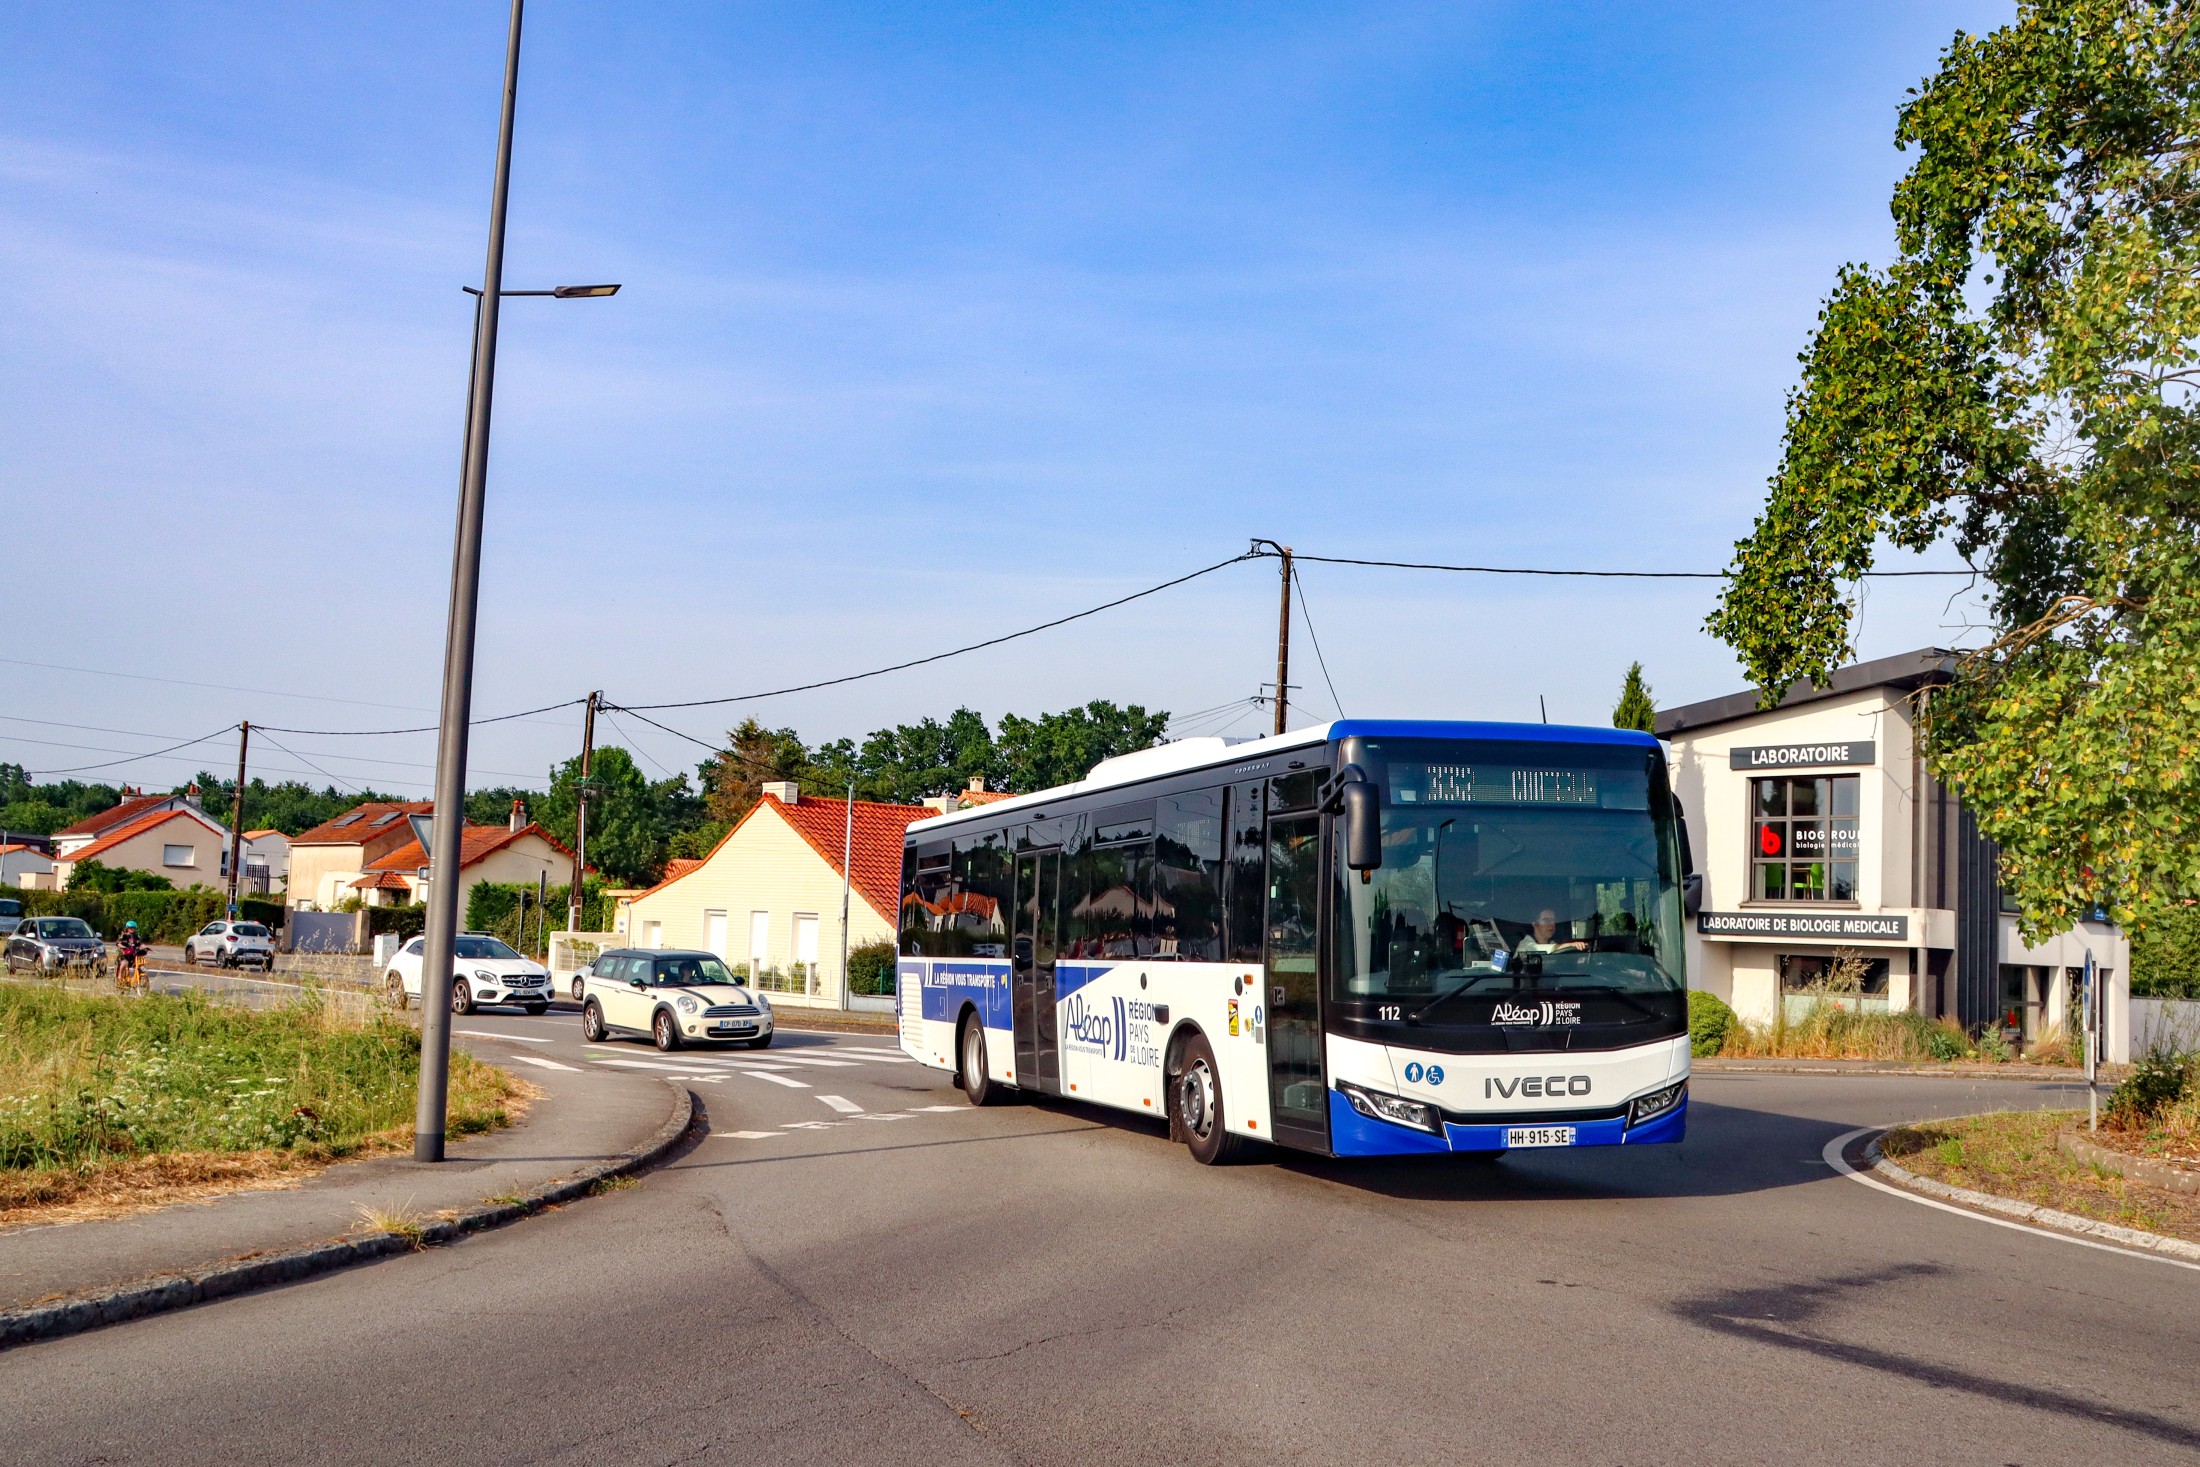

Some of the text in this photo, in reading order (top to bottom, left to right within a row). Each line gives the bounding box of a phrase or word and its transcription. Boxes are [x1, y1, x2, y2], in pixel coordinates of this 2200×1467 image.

[1751, 746, 1849, 764] LABORATOIRE
[1703, 917, 1899, 933] LABORATOIRE DE BIOLOGIE MEDICALE
[934, 972, 940, 984] LA
[955, 973, 967, 986] VOUS
[966, 973, 996, 988] TRANSPORTE
[1128, 998, 1156, 1022] RÉGION
[1378, 1006, 1400, 1020] 112
[1555, 1001, 1581, 1010] RÉGION
[1562, 1016, 1581, 1025] LOIRE
[1129, 1023, 1149, 1044] PAYS
[1137, 1046, 1160, 1068] LOIRE
[1485, 1076, 1592, 1099] IVECO
[1510, 1129, 1568, 1144] HH-915-SE
